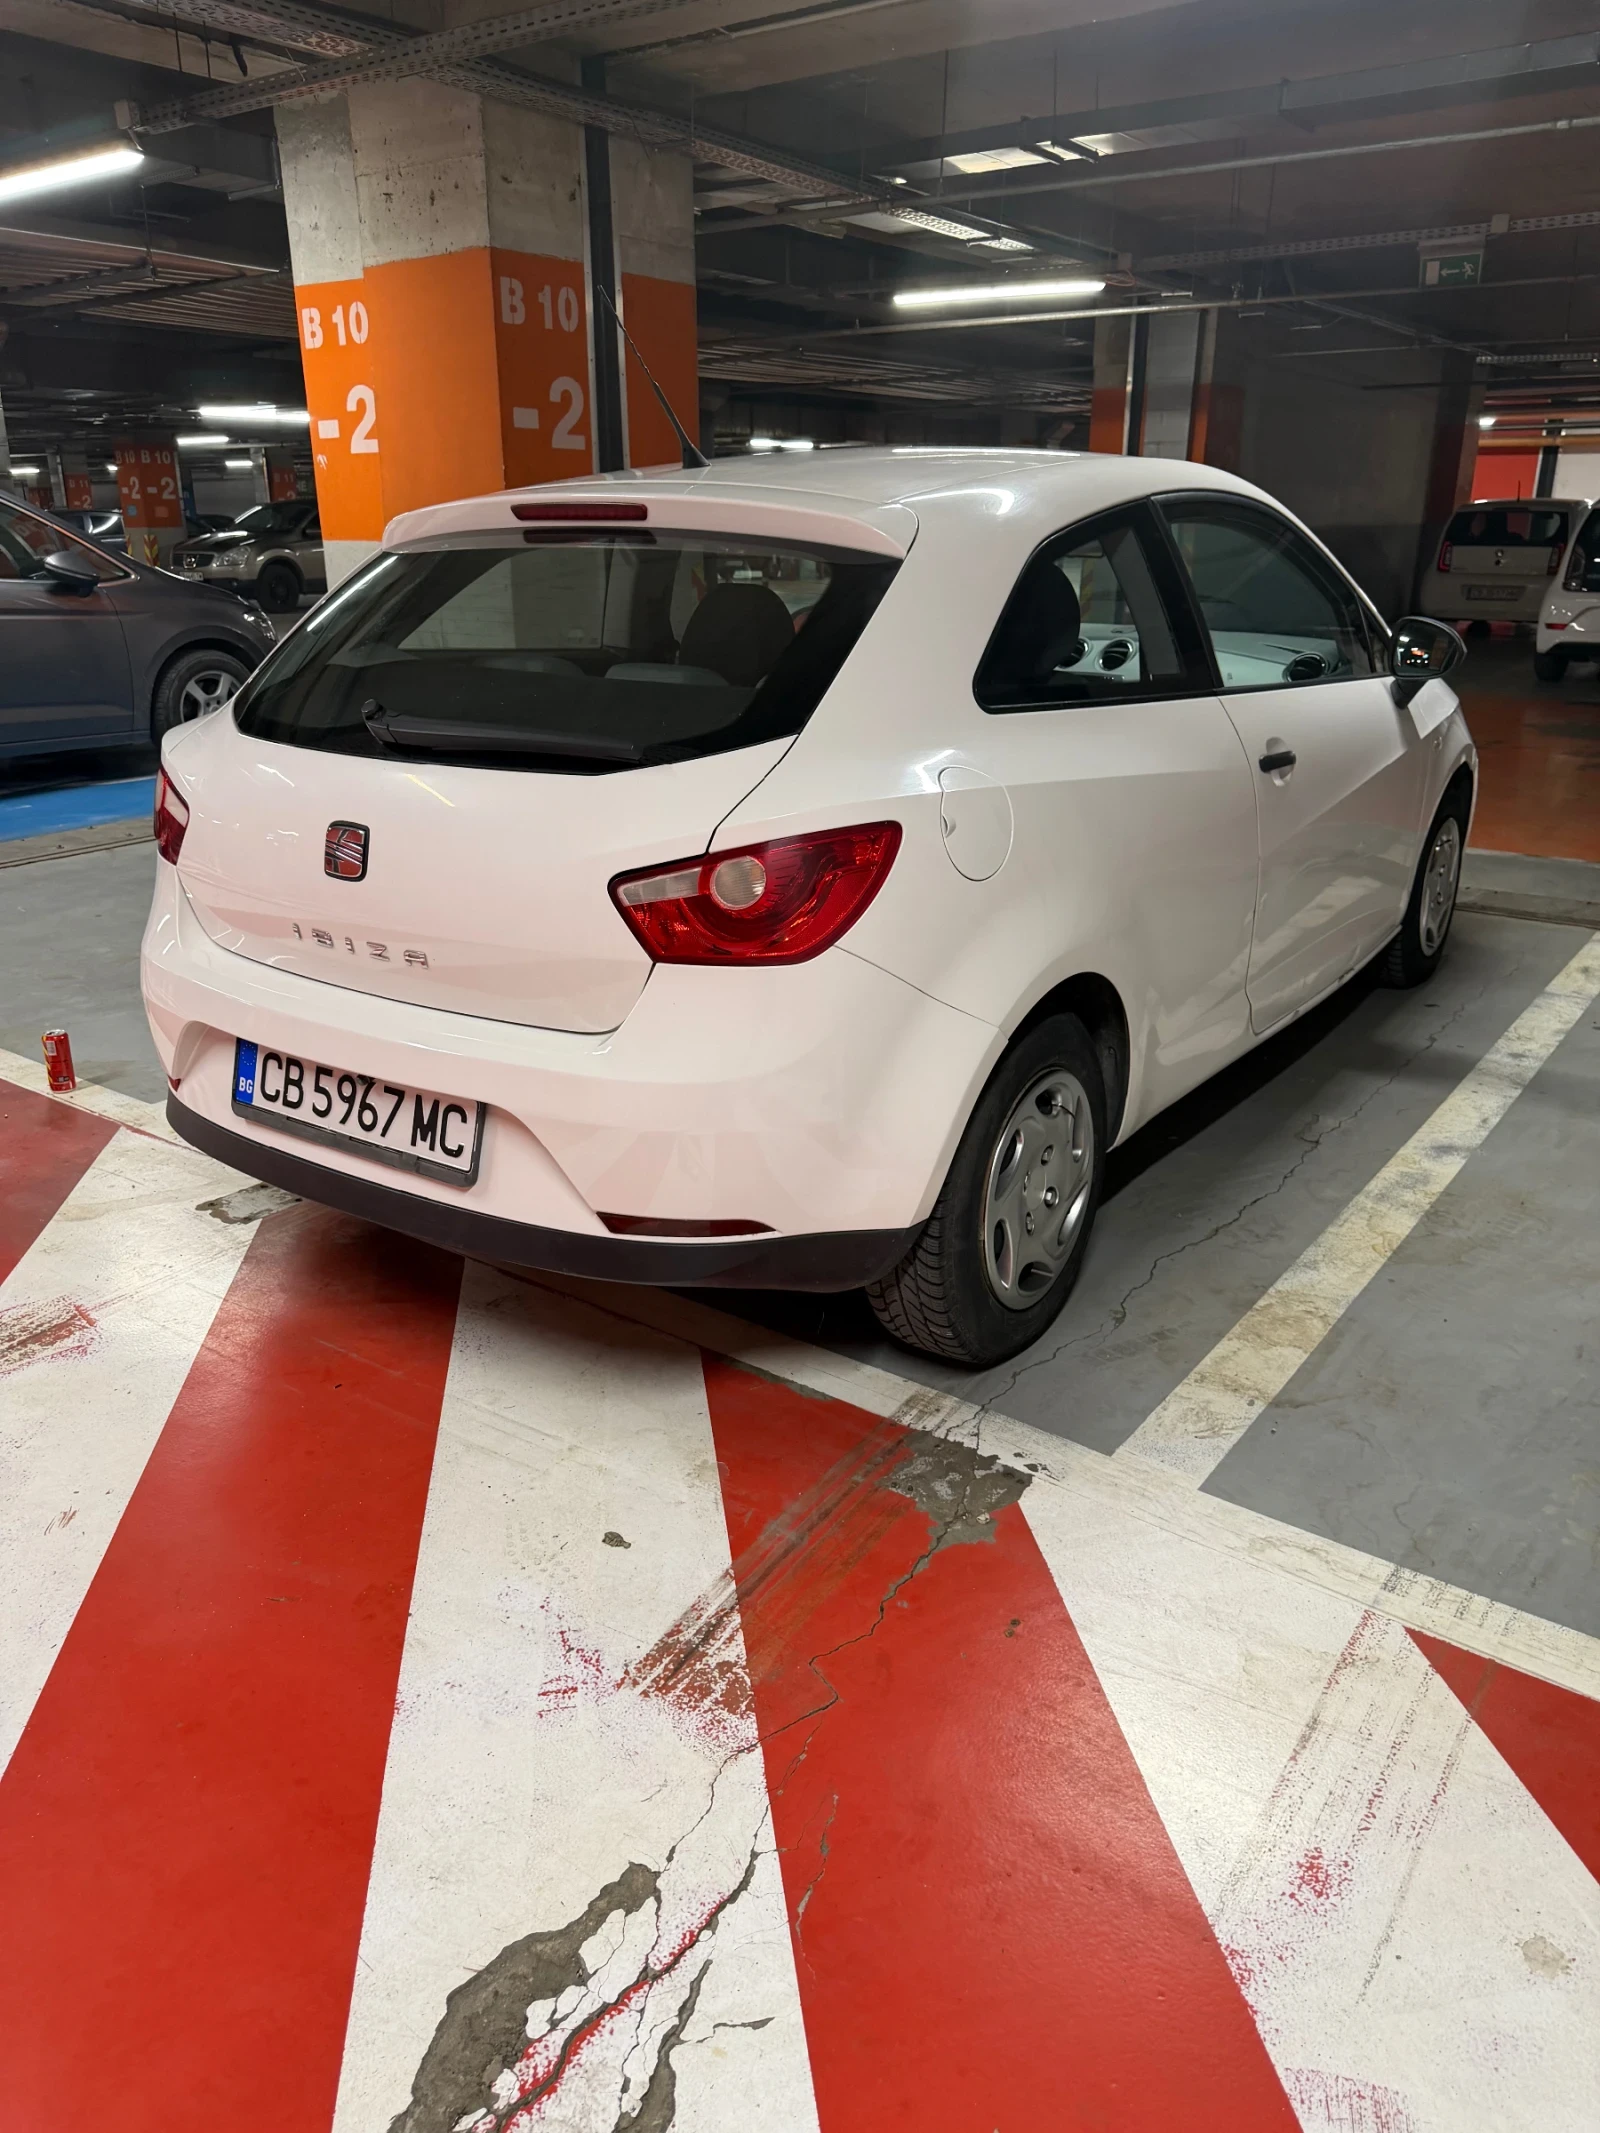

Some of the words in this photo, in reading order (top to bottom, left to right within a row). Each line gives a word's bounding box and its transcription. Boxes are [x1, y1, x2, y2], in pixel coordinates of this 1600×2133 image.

[302, 307, 324, 350] B
[331, 301, 369, 346] 10
[500, 276, 526, 325] B
[537, 284, 579, 333] 10
[124, 449, 136, 464] 10
[141, 449, 151, 464] B
[155, 450, 171, 464] 10
[292, 922, 429, 970] IBIZA
[239, 1077, 253, 1093] BG
[260, 1052, 305, 1110] CB
[311, 1065, 406, 1138] 5967
[410, 1094, 468, 1158] MC
